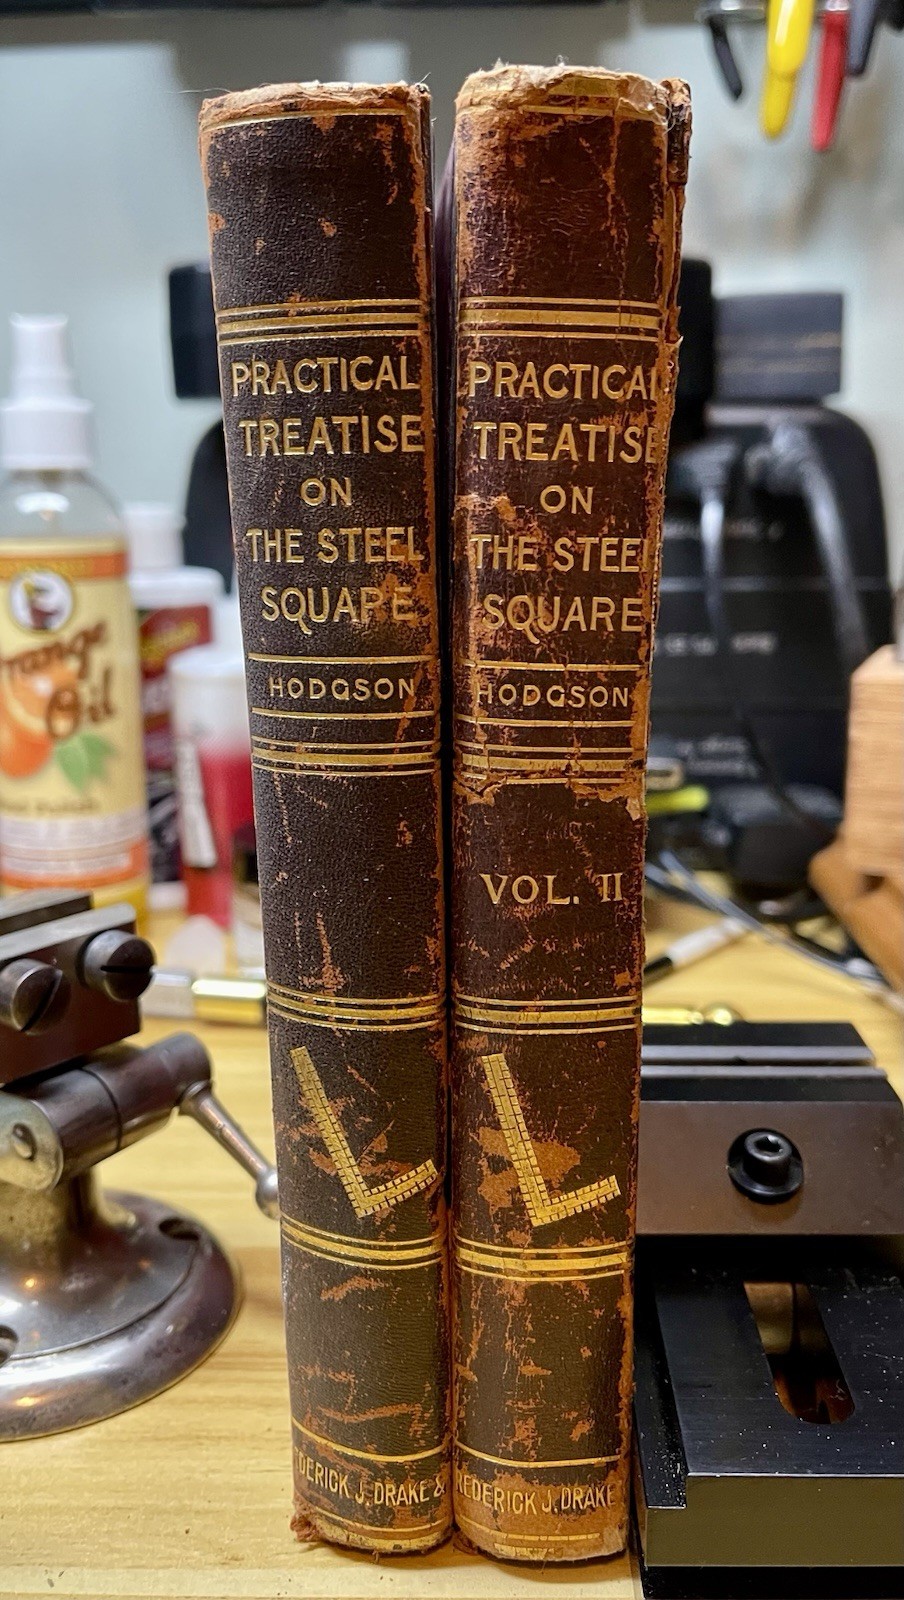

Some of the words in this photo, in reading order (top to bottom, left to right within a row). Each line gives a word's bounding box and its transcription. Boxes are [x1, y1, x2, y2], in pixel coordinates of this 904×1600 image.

[231, 355, 421, 397] PRACTICAL
[239, 414, 425, 457] TREATISE
[473, 421, 659, 463] TREATISE
[301, 477, 352, 506] ON
[540, 485, 594, 514] ON
[246, 528, 304, 564] THE
[317, 526, 424, 564] STEEL
[469, 534, 538, 572] THE
[261, 585, 416, 634] SQUARE
[482, 593, 642, 645] SQUARE
[269, 677, 414, 701] HODGSON
[475, 683, 629, 708] HODGSON
[481, 873, 580, 906] VOL.
[600, 873, 624, 901] II
[295, 1446, 350, 1499] DERICK
[373, 1480, 430, 1507] DRAKE
[560, 1484, 616, 1511] DRAKE
